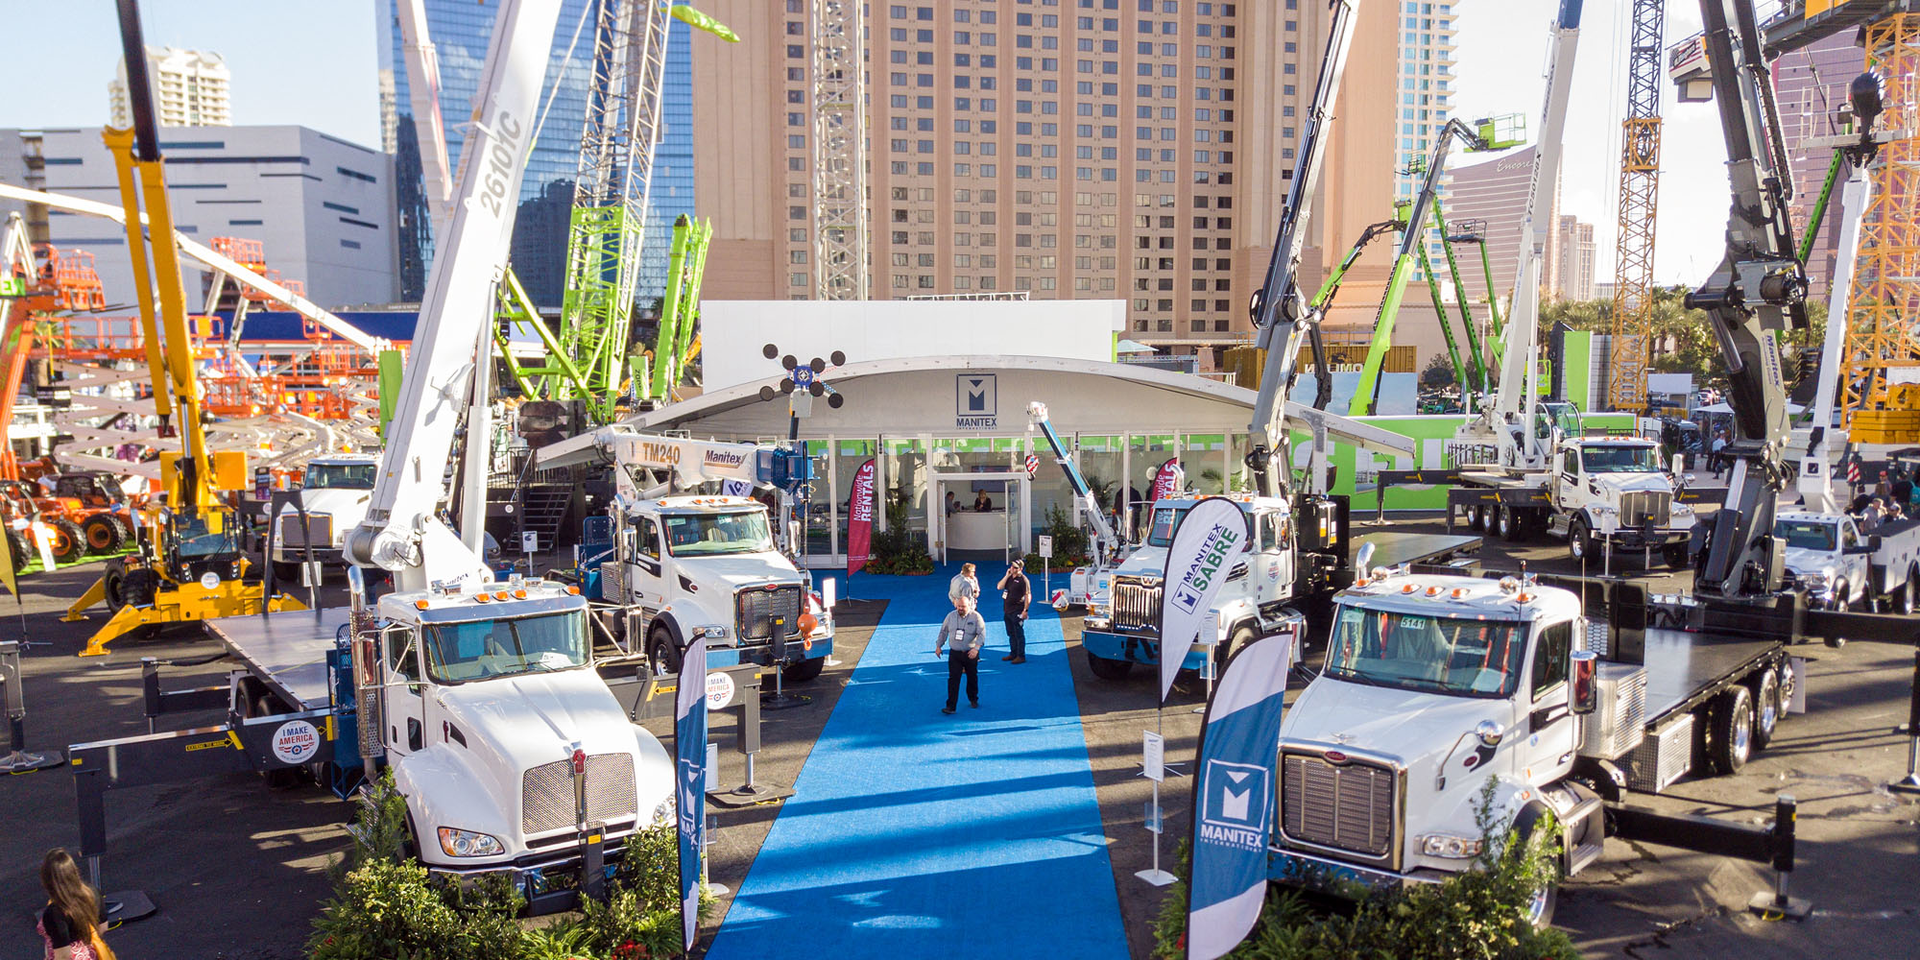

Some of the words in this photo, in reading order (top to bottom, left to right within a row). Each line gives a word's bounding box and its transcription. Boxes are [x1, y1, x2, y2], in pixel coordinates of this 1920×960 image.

[480, 111, 521, 219] 26101C
[1765, 334, 1780, 387] Manitex
[956, 417, 998, 427] MANITEX
[643, 442, 681, 465] TM240
[704, 449, 742, 465] Manitex
[861, 464, 875, 522] RENTALS
[1183, 522, 1223, 584] MANITEX
[1193, 527, 1239, 592] SABRE
[1402, 618, 1425, 629] 5141
[706, 683, 730, 692] MERICA
[279, 733, 314, 746] AMERICA
[286, 726, 309, 737] MAKE
[1200, 823, 1263, 848] MANITEX
